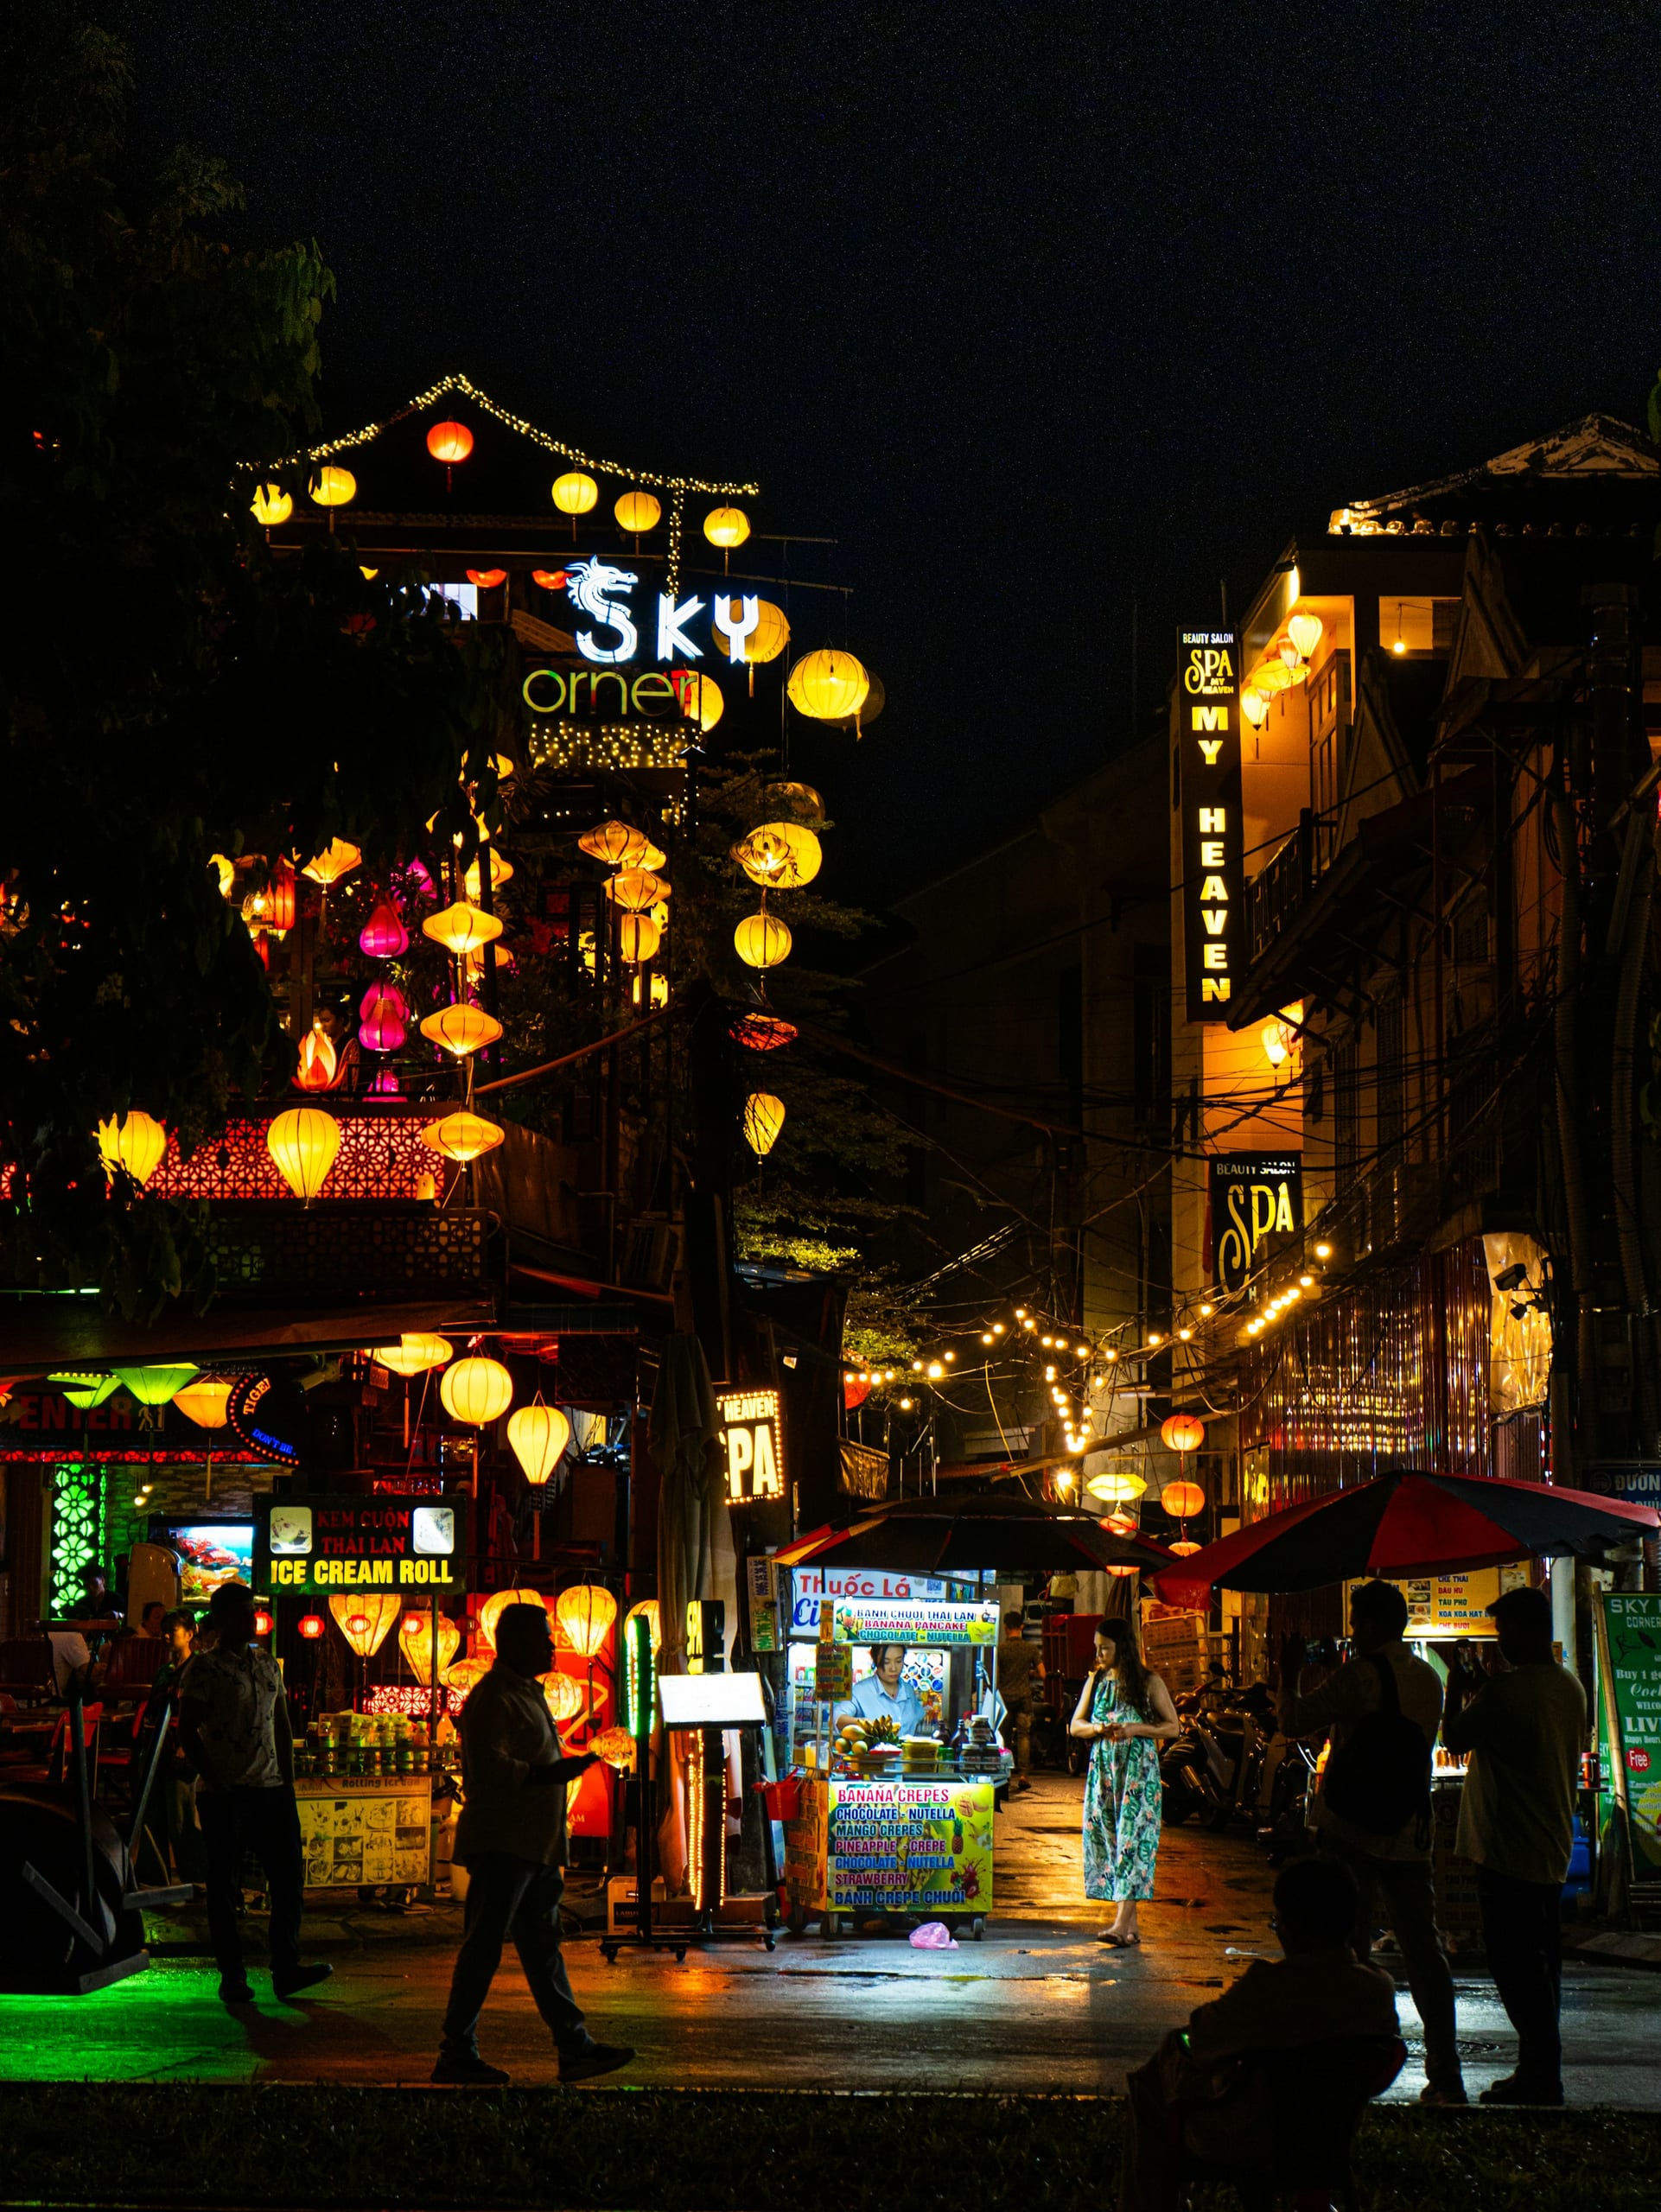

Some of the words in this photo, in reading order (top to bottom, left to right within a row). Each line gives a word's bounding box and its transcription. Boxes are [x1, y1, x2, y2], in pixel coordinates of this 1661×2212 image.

[564, 554, 759, 664] SKY
[1183, 633, 1209, 644] BEAUTY
[1211, 633, 1233, 644] SALON
[1185, 650, 1233, 694] SPA
[1199, 808, 1231, 1001] HEAVEN
[1217, 1163, 1256, 1175] BEAUTY
[1219, 1182, 1294, 1302] SPA
[724, 1396, 774, 1422] HEAVEN
[719, 1425, 779, 1497] PA
[369, 1536, 406, 1554] LAN
[270, 1560, 307, 1584] ICE
[314, 1560, 393, 1584] CREAM
[400, 1560, 454, 1584] ROLL
[1611, 1599, 1649, 1614] SKY
[860, 1630, 917, 1640] CHOCOLATE
[926, 1632, 971, 1641] NUTELLA
[1616, 1669, 1638, 1681] Buy
[1625, 1716, 1661, 1732] LIV
[1629, 1750, 1648, 1767] Free
[838, 1789, 893, 1802] BANANA
[898, 1789, 949, 1802] CREPES
[837, 1808, 898, 1820] CHOCOLATE
[908, 1808, 955, 1820] NUTELLA
[837, 1825, 876, 1836] MANGO
[881, 1825, 923, 1836] CREPES
[836, 1840, 895, 1853] PINEAPPLE
[911, 1840, 945, 1852] CREPE
[836, 1857, 896, 1868] CHOCOLATE
[836, 1873, 907, 1885] STRAWBERRY
[877, 1891, 920, 1904] CREPE
